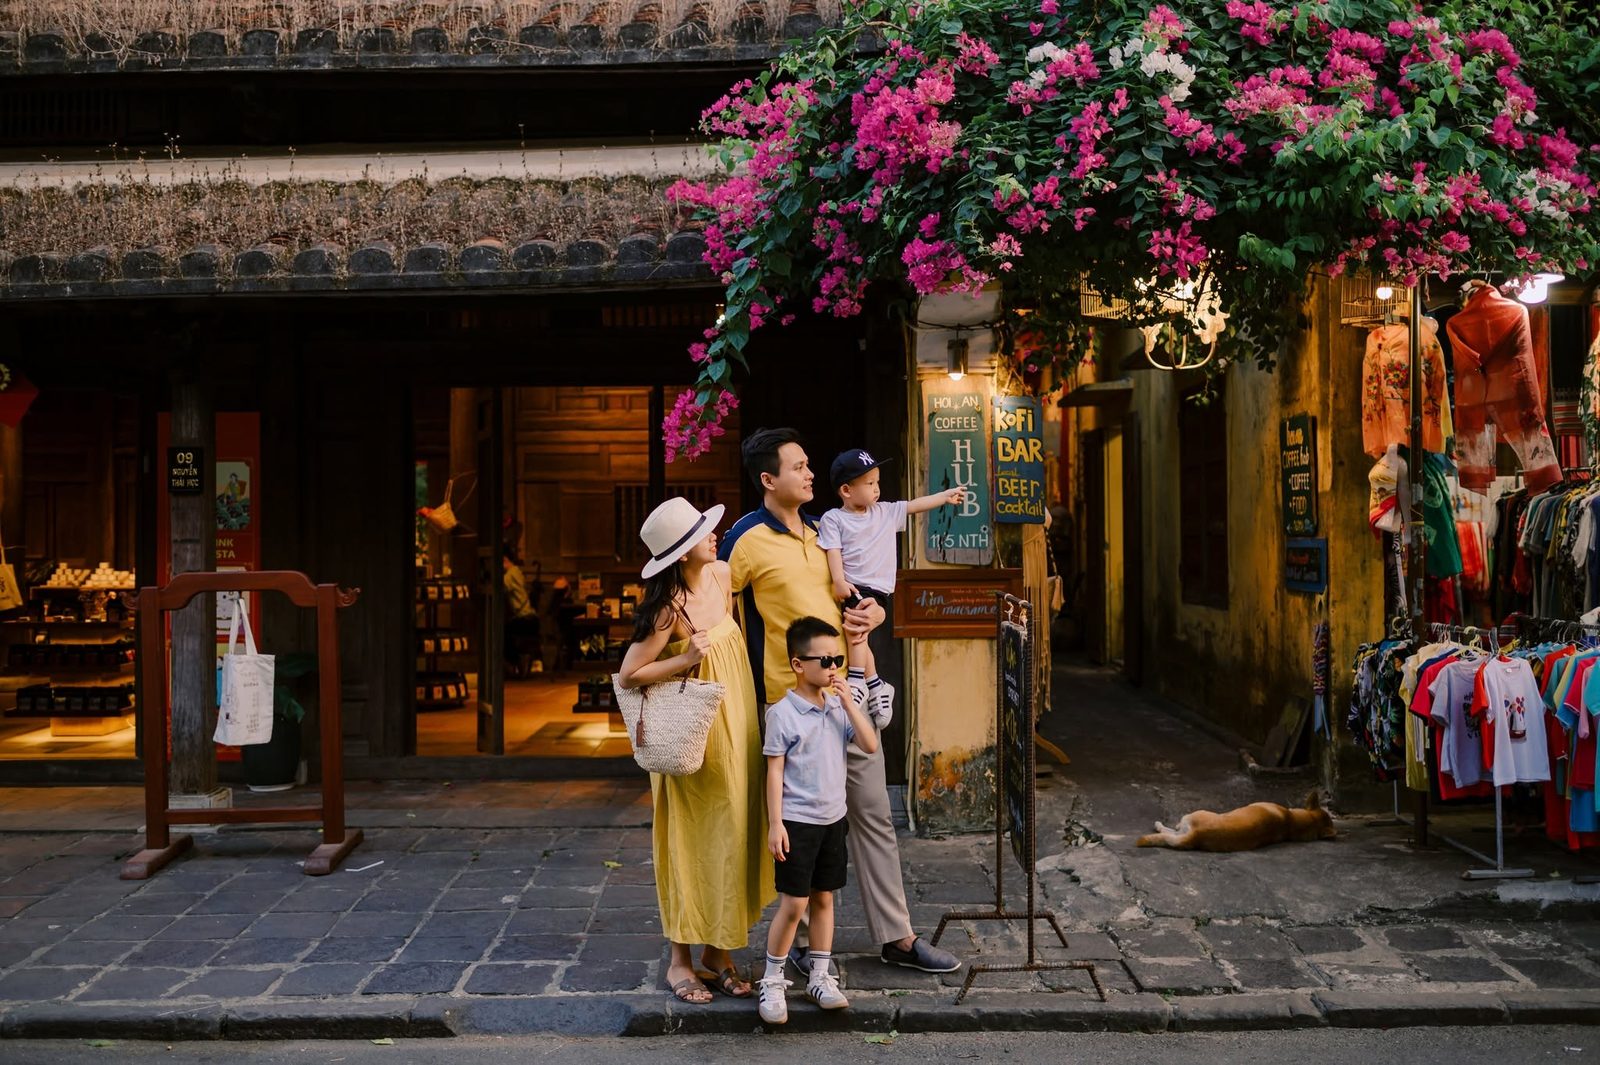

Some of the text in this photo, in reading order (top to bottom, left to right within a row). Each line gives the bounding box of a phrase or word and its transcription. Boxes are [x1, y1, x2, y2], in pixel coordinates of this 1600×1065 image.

[961, 395, 979, 407] AN
[934, 416, 978, 429] COFFEE
[997, 437, 1044, 463] BAR
[176, 452, 194, 464] 09
[951, 438, 981, 517] HUB
[1291, 472, 1310, 490] COFFEE
[959, 533, 989, 548] NTH
